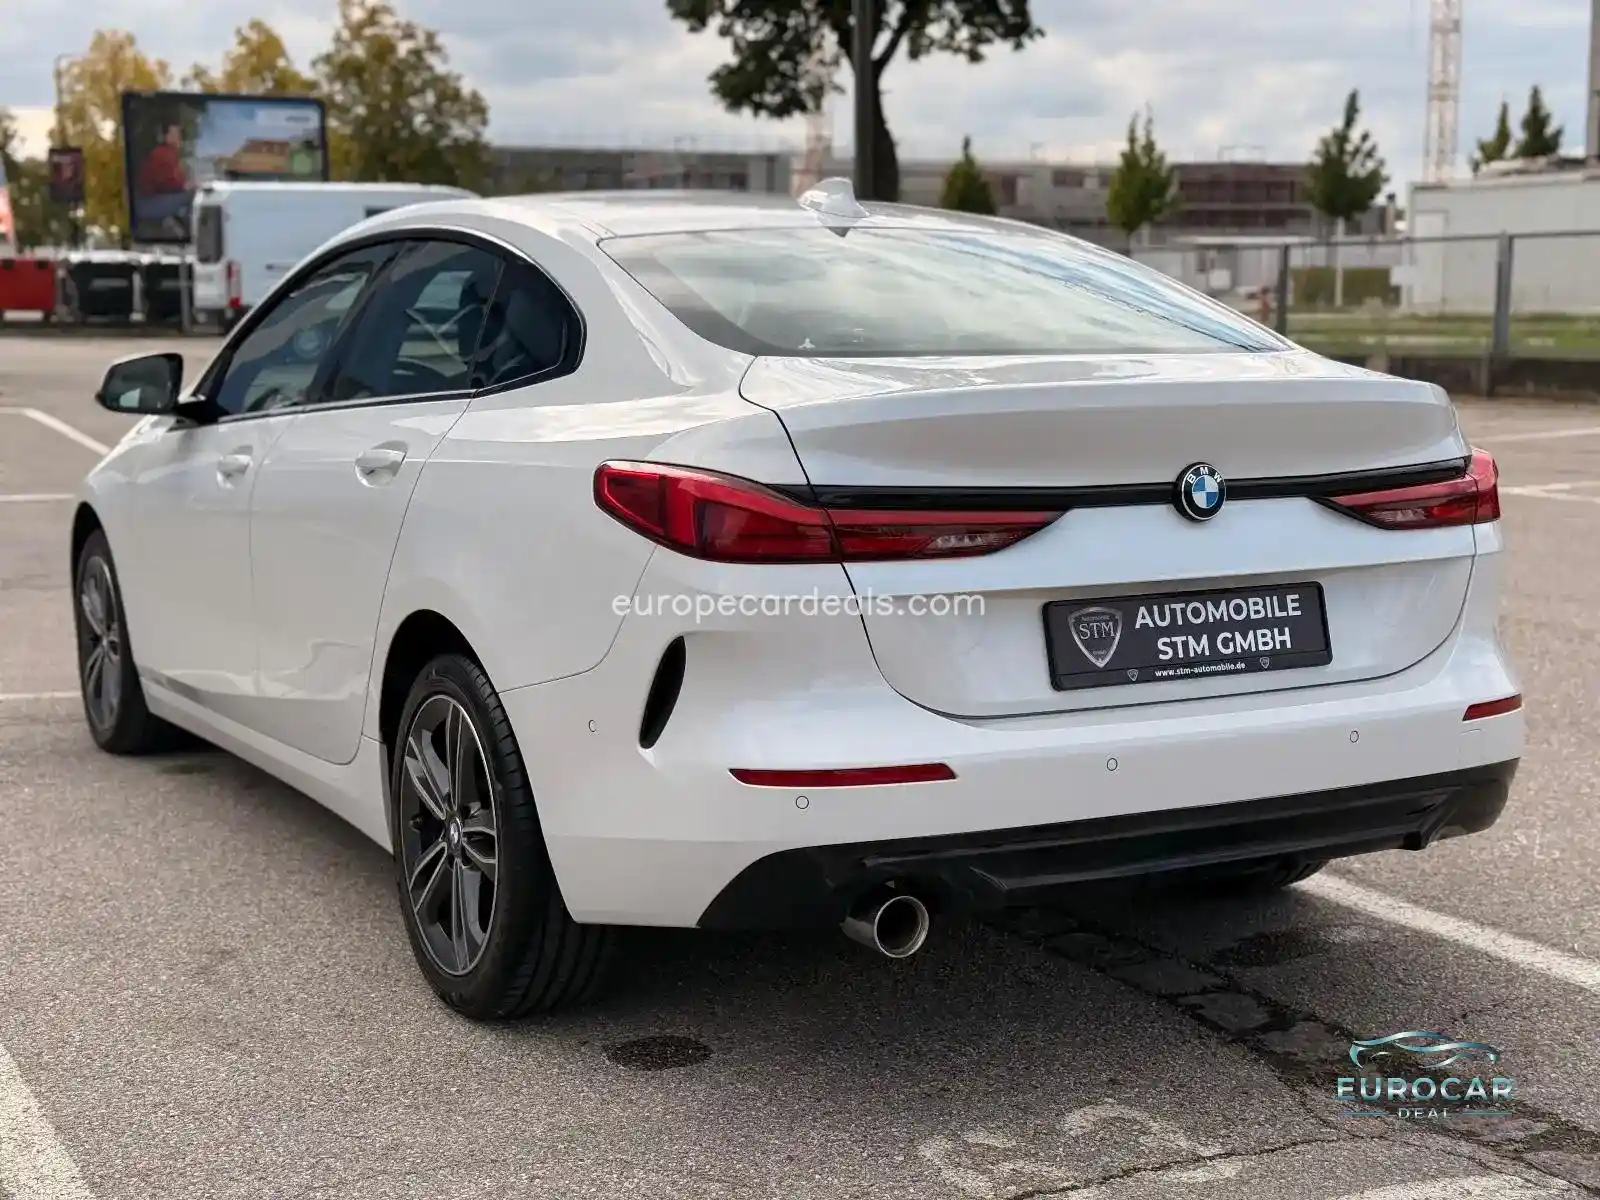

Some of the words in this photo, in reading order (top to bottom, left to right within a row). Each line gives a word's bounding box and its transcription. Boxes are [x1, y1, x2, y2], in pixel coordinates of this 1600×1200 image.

[1187, 467, 1221, 483] BMW
[1135, 594, 1301, 628] AUTOMOBILE
[1079, 621, 1115, 639] STM
[1157, 634, 1210, 660] STM
[1216, 627, 1292, 655] GMBH
[1154, 662, 1246, 677] www.stm-automobile.de
